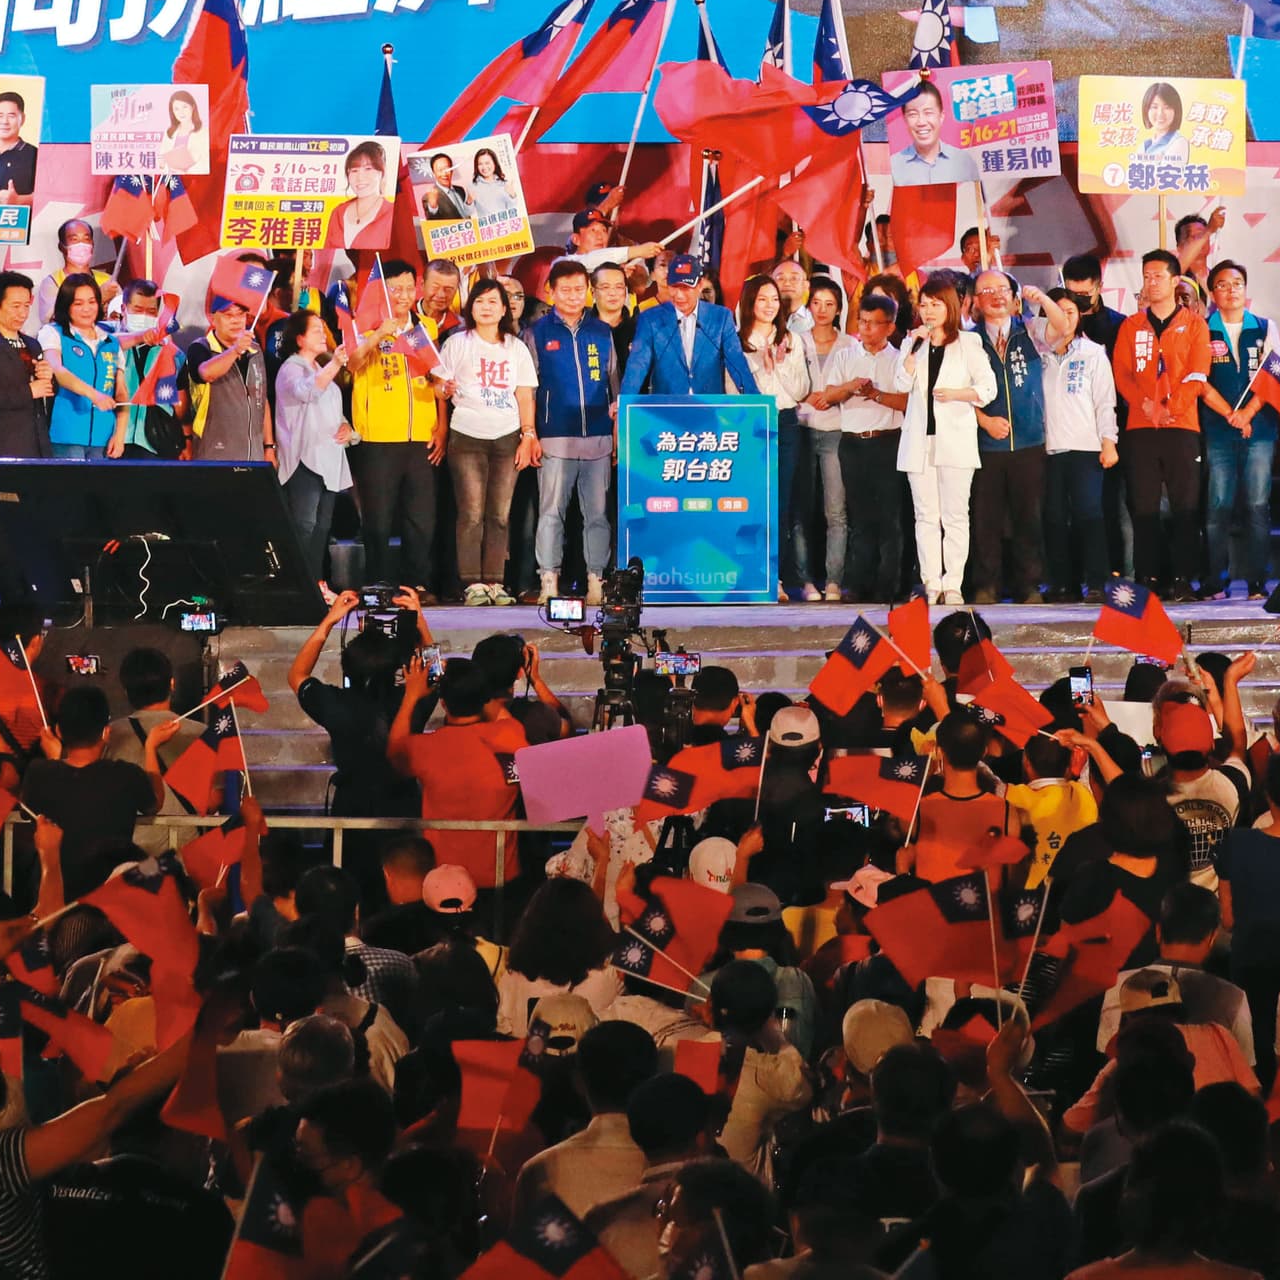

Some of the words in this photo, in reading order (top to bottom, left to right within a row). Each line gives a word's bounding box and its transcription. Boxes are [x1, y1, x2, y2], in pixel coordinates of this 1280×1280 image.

[951, 74, 1010, 103] 幹大事
[1093, 102, 1132, 124] 陽光
[1187, 102, 1228, 125] 勇敢
[232, 140, 258, 151] KMT
[1099, 126, 1138, 147] 女孩
[1190, 126, 1234, 152] 承擔
[95, 151, 156, 170] 陳玫娟
[271, 177, 336, 193] 電話民調
[233, 200, 276, 212] 懇請回答
[280, 201, 324, 212] 唯一支持
[226, 216, 322, 247] 李雅靜
[430, 220, 473, 239] 最強CEO
[432, 230, 476, 253] 郭台銘
[476, 356, 511, 390] 挺
[656, 431, 739, 452] 為台為民
[661, 458, 733, 481] 郭台銘
[642, 568, 737, 589] aohsiung
